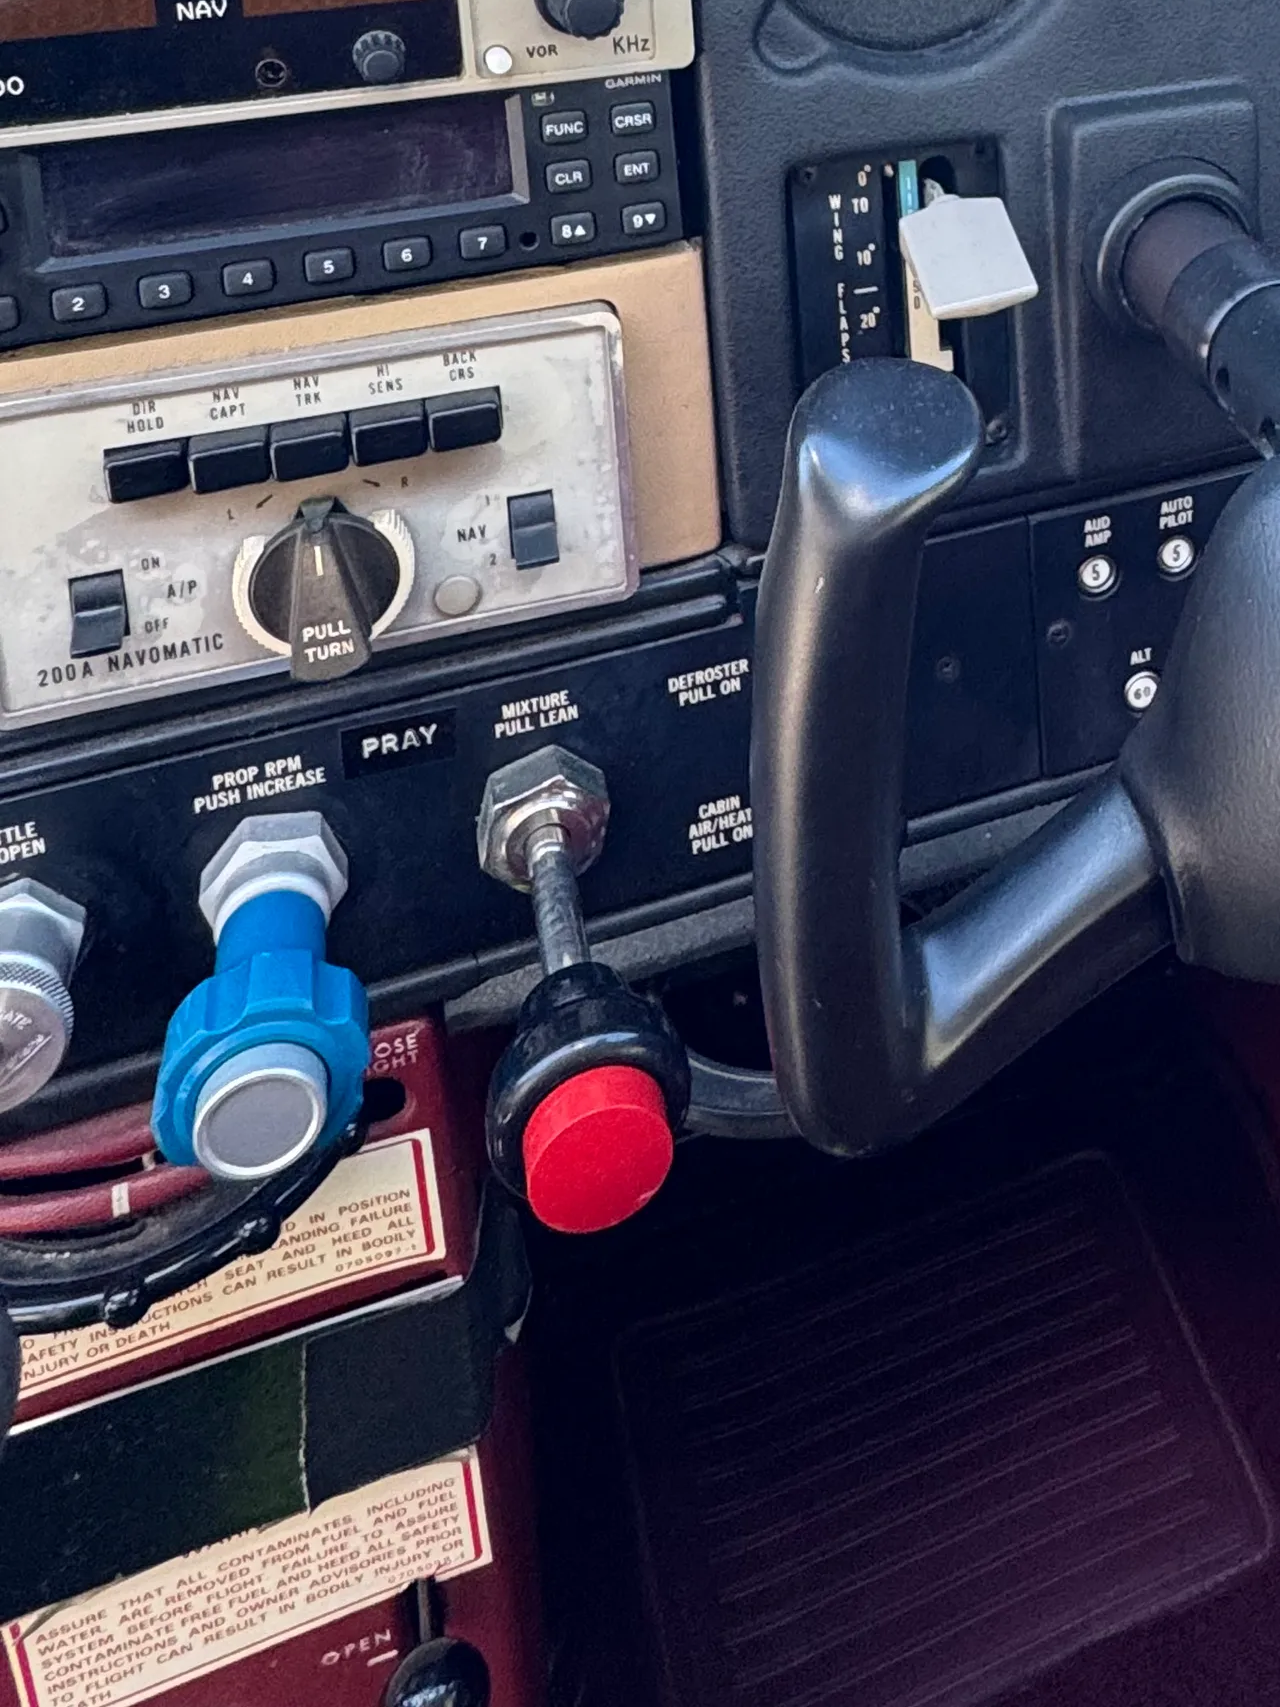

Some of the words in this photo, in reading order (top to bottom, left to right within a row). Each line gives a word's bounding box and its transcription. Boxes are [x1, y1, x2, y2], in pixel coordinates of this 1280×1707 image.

[525, 44, 559, 59] VOR
[612, 35, 651, 55] KHz
[604, 73, 662, 90] GARMIN
[545, 121, 584, 136] FUNC
[614, 112, 653, 129] CRSR
[554, 170, 583, 186] CLR
[623, 161, 651, 177] ENT
[851, 197, 869, 214] TO
[476, 235, 488, 251] 7
[400, 247, 413, 262] 6
[321, 259, 335, 274] 5
[241, 271, 254, 286] 4
[157, 284, 171, 299] 3
[71, 296, 85, 312] 2
[442, 350, 477, 367] BACK
[376, 364, 390, 378] HI
[449, 366, 475, 382] CRS
[293, 375, 320, 391] NAV
[368, 378, 403, 395] SENS
[212, 387, 240, 403] NAV
[295, 392, 322, 407] TRK
[132, 400, 157, 416] DIR
[210, 402, 246, 421] CAPT
[126, 416, 165, 434] HOLD
[1160, 495, 1194, 515] AUTO
[1083, 515, 1111, 534] AUD
[1159, 509, 1194, 530] PILOT
[456, 524, 487, 543] NAV
[1084, 530, 1112, 548] AMP
[140, 556, 161, 571] ON
[1091, 563, 1101, 582] 5
[167, 579, 198, 599] A/P
[144, 617, 169, 633] OFF
[302, 619, 352, 643] PULL
[107, 633, 225, 673] NAVOMATIC
[304, 638, 355, 663] TURN
[1129, 647, 1152, 666] ALT
[667, 658, 750, 693] DEFROSTER
[678, 684, 716, 707] PULL
[719, 676, 742, 696] ON
[501, 690, 570, 720] MIXTURE
[493, 721, 534, 739] PULL
[538, 704, 579, 729] LEAN
[361, 723, 438, 759] PRAY
[211, 766, 259, 791] PROP
[264, 754, 303, 778] RPM
[192, 790, 241, 814] PUSH
[246, 766, 327, 801] INCREASE
[698, 794, 741, 820] CABIN
[688, 807, 752, 840] AIR/HEAT
[691, 831, 729, 855] PULL
[731, 823, 753, 843] ON
[308, 1211, 327, 1225] IN
[338, 1188, 411, 1217] POSITION
[350, 1201, 413, 1228] FAILURE
[224, 1258, 266, 1281] SEAT
[281, 1243, 317, 1262] AND
[331, 1227, 373, 1248] HEED
[387, 1216, 415, 1231] ALL
[222, 1278, 258, 1296] CAN
[266, 1254, 327, 1282] RESULT
[336, 1245, 353, 1260] IN
[361, 1228, 417, 1252] BODILY
[35, 1608, 108, 1645] ASSURE
[118, 1585, 166, 1611] THAT
[176, 1570, 208, 1590] ALL
[217, 1513, 354, 1572] CONTAMINATES
[366, 1476, 457, 1517] INCLUDING
[43, 1621, 176, 1683] CONTAMINATE
[180, 1604, 223, 1629] FREE
[228, 1585, 274, 1608] FUEL
[275, 1568, 312, 1590] AND
[316, 1549, 367, 1573] HEED
[366, 1537, 395, 1555] ALL
[401, 1513, 462, 1542] SAFETY
[320, 1628, 392, 1667] OPEN
